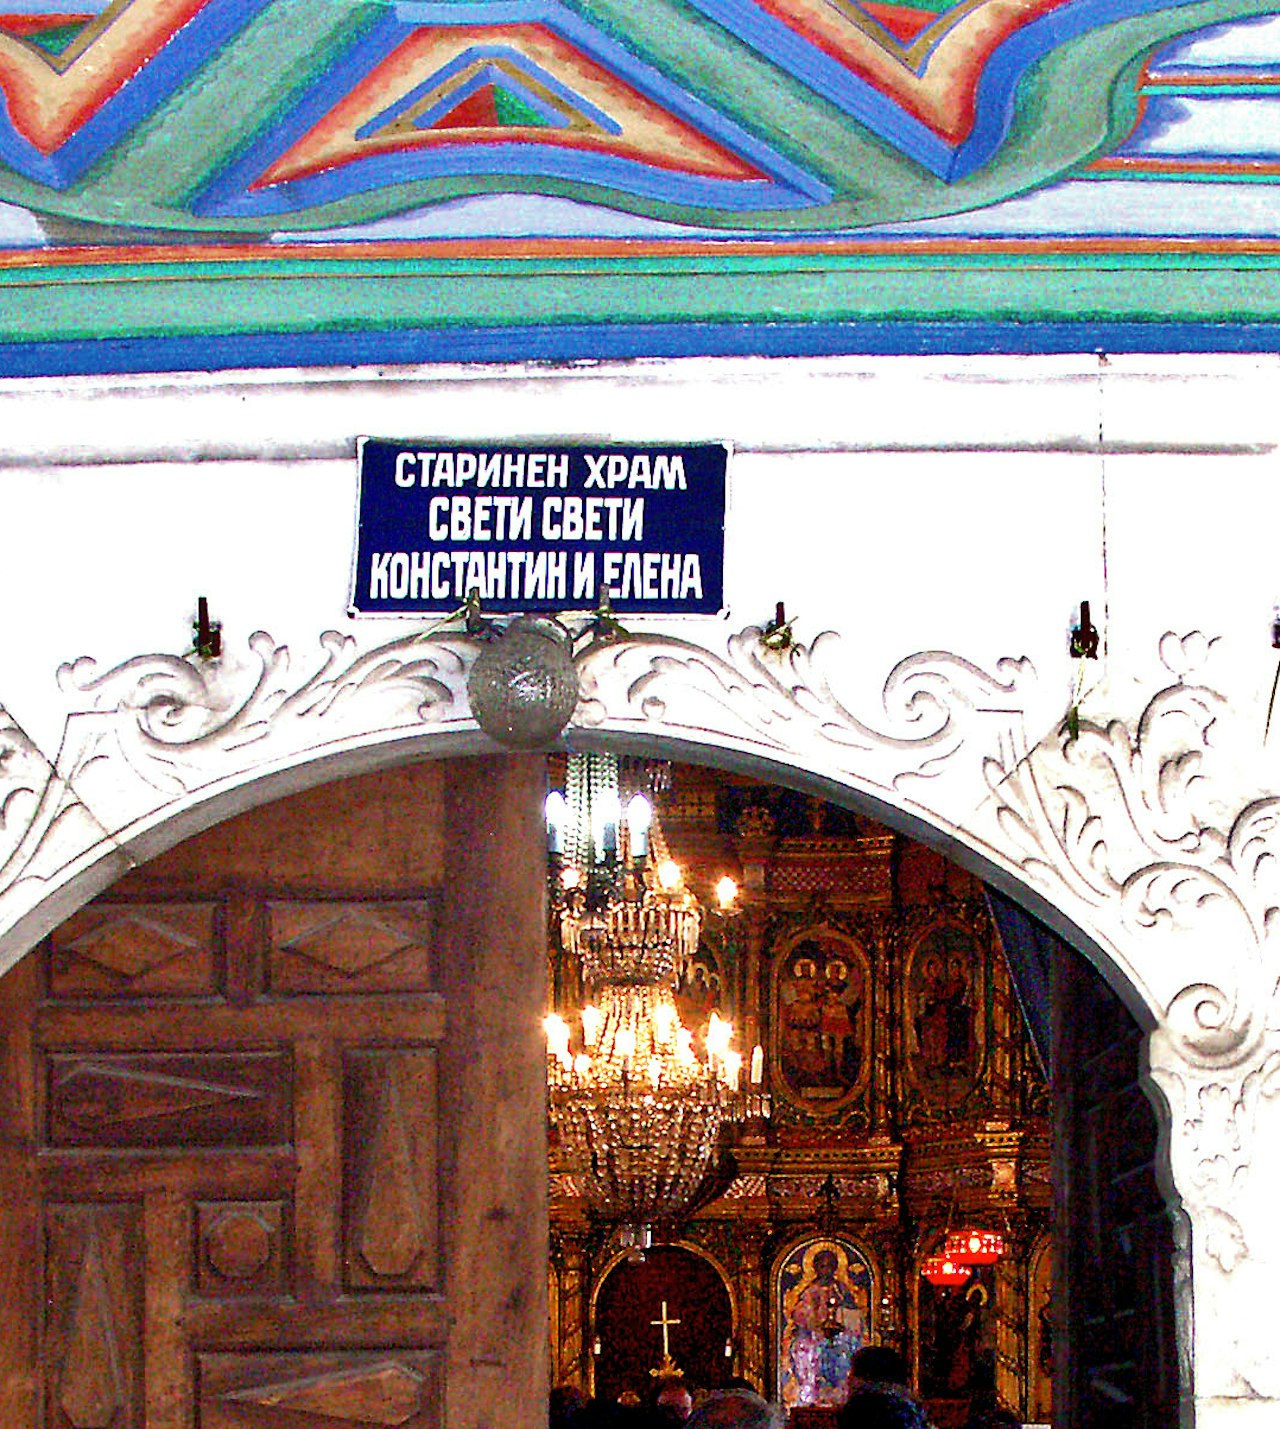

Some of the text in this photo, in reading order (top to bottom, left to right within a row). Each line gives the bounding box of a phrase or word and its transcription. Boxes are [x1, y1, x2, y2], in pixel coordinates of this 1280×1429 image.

[395, 452, 688, 490] СТАРИНЕН ХРАМ
[428, 496, 646, 541] СВЕТИ СВЕТИ
[369, 551, 704, 600] КОНСТАНТИН И ЕЛЕНА
